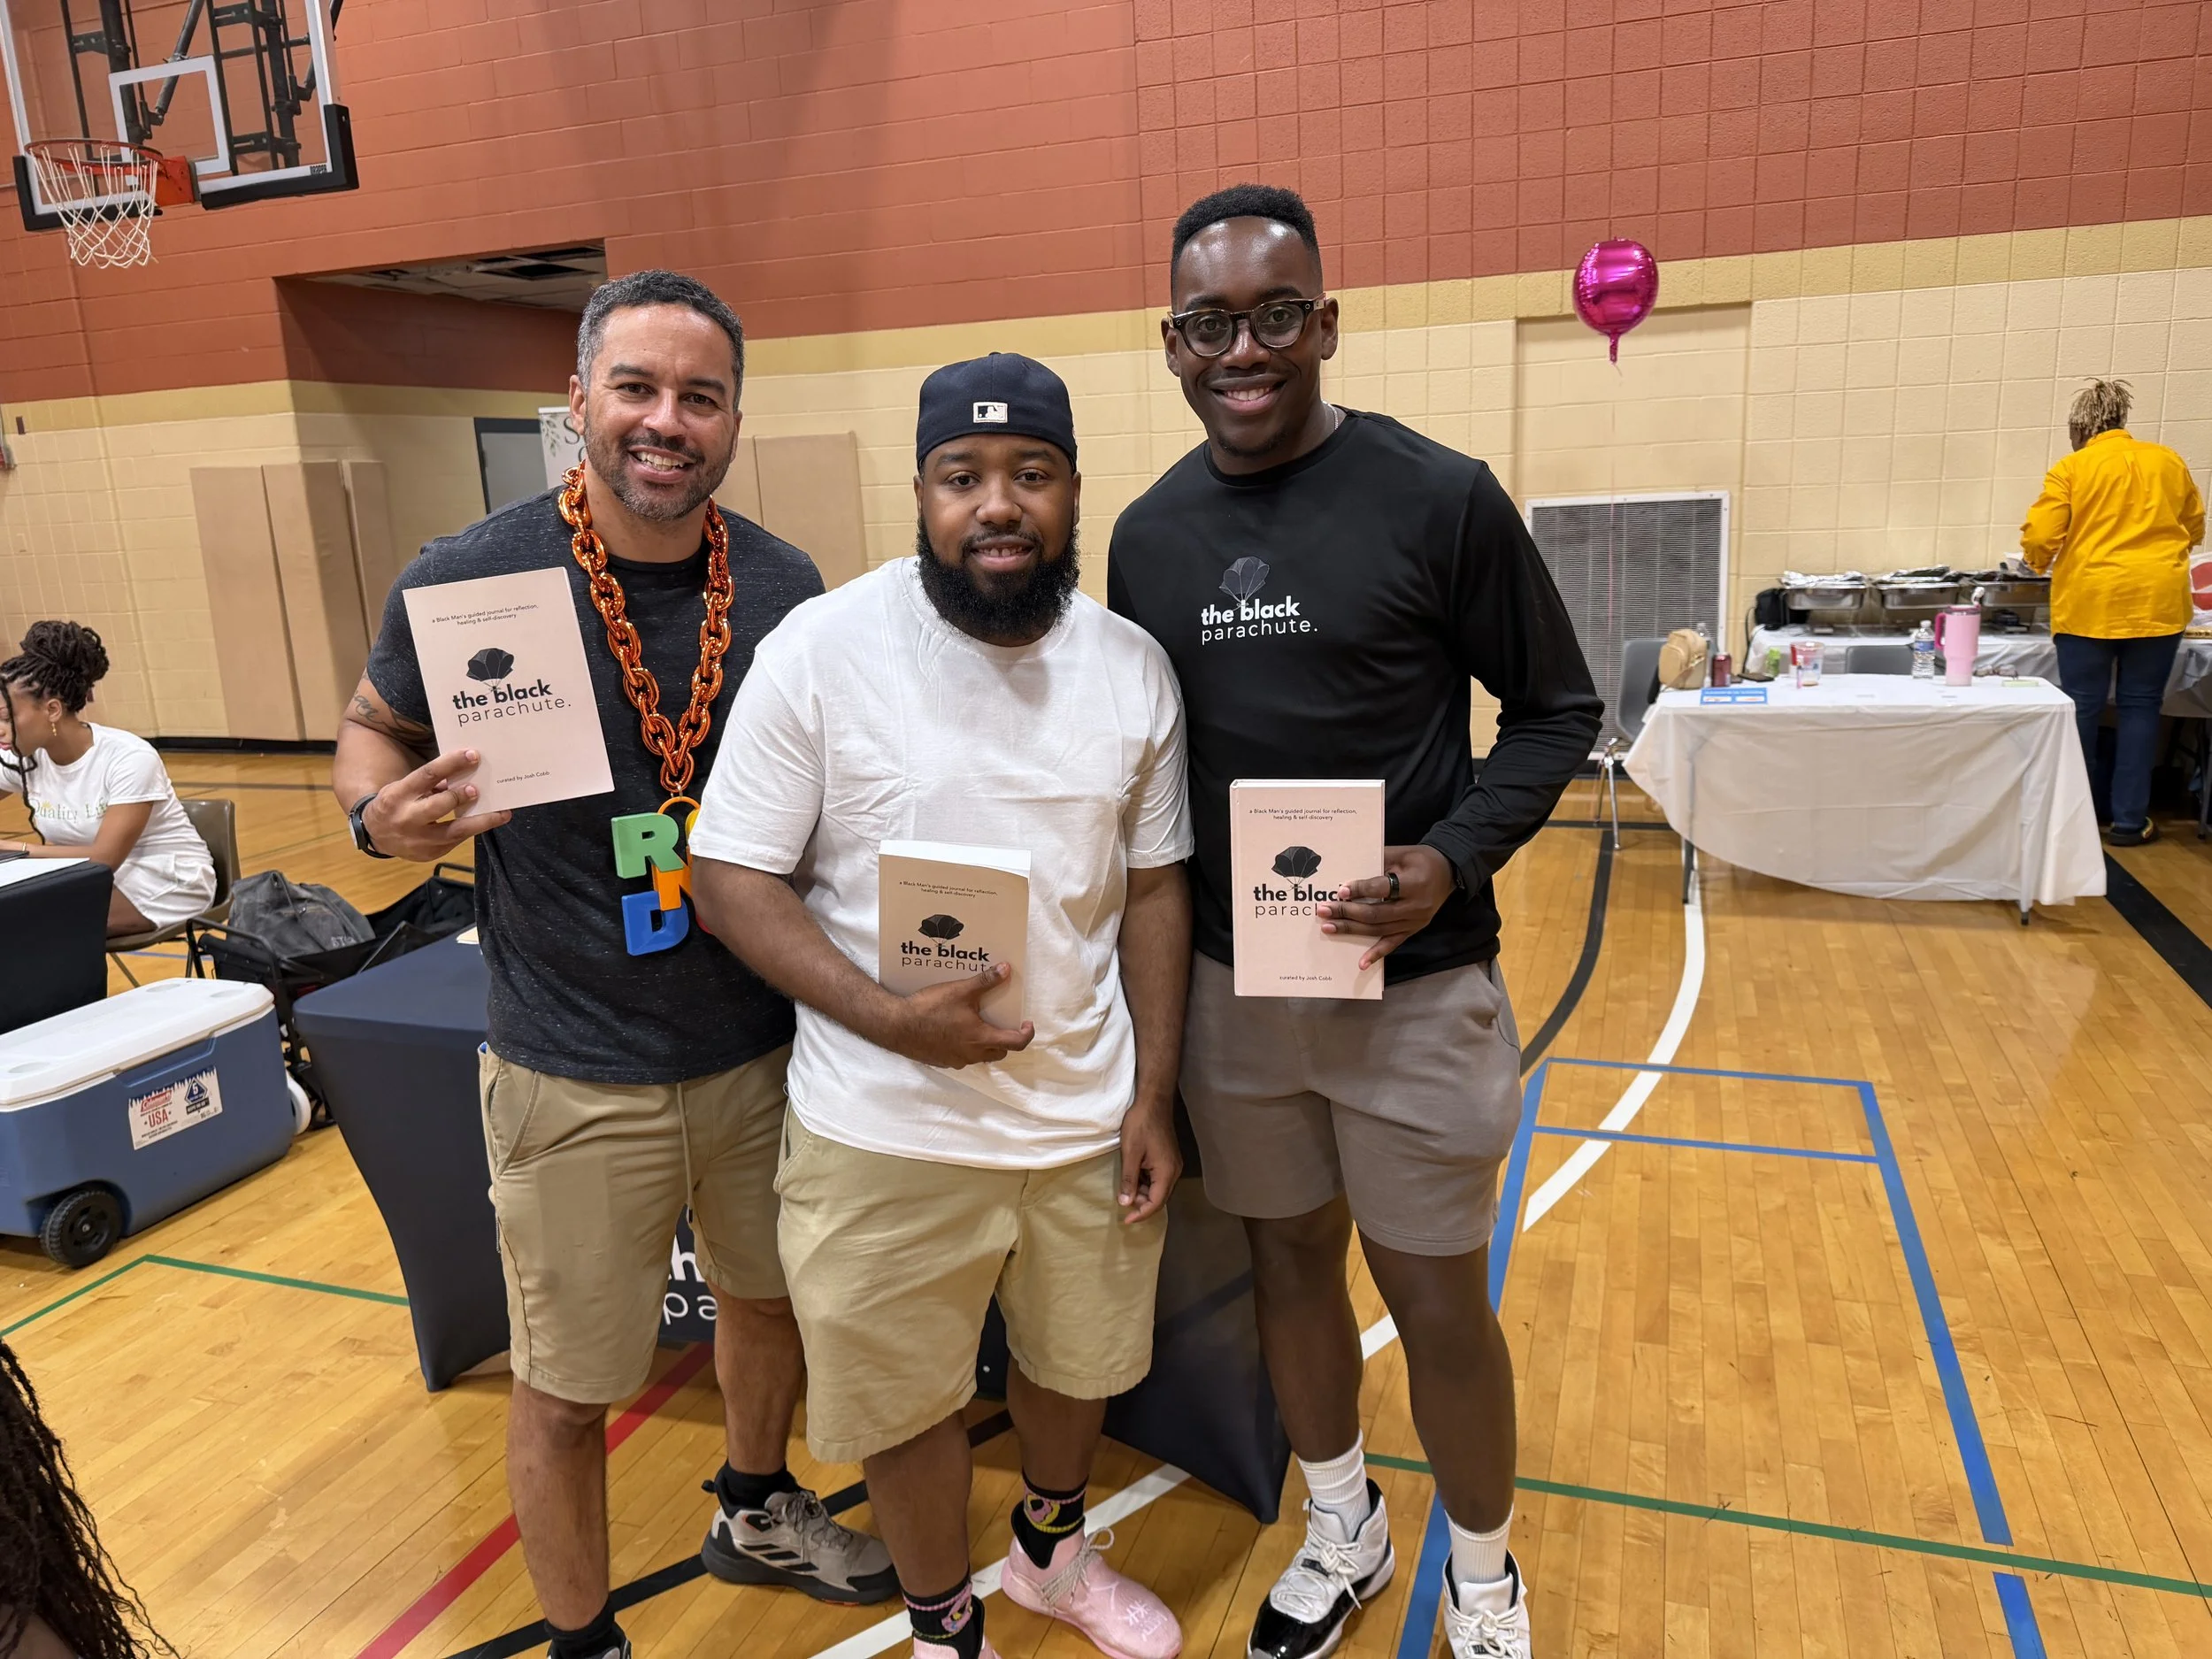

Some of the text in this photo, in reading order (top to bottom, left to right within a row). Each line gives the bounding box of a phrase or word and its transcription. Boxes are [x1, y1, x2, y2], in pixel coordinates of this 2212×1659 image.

[487, 608, 504, 617] journal
[1201, 595, 1301, 626] the black
[1202, 618, 1318, 646] parachute.
[452, 679, 553, 710] the black
[457, 697, 572, 727] parachute.
[1253, 883, 1352, 902] the blac
[901, 941, 990, 963] the black
[902, 956, 992, 972] parachut
[149, 1108, 169, 1128] USA
